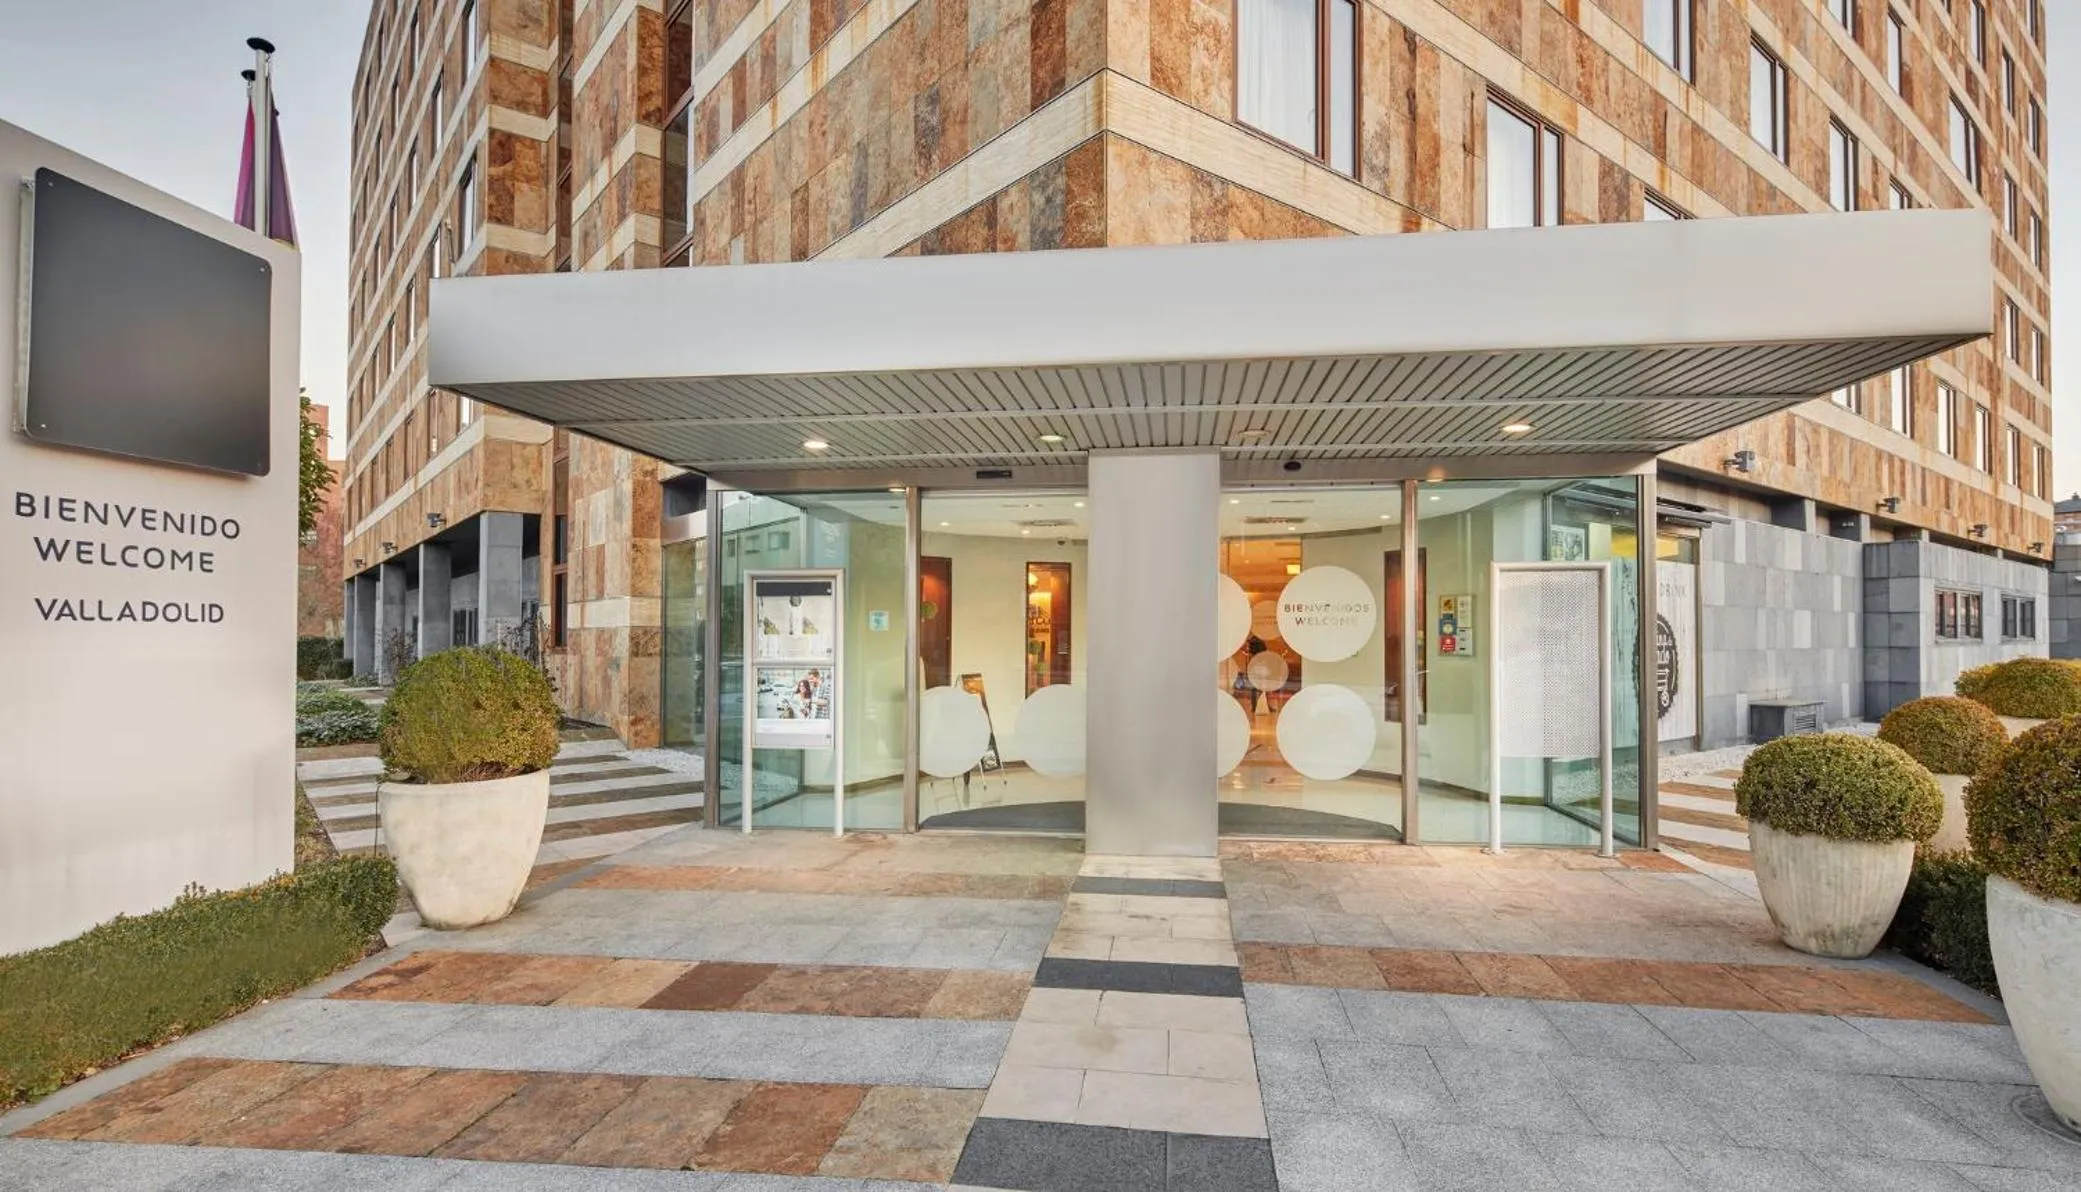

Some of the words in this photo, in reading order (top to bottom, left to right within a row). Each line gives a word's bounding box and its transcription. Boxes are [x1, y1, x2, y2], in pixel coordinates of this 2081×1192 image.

[15, 491, 241, 540] BIENVENIDO
[33, 536, 215, 573] WELCOME
[34, 597, 225, 624] VALLADOLID
